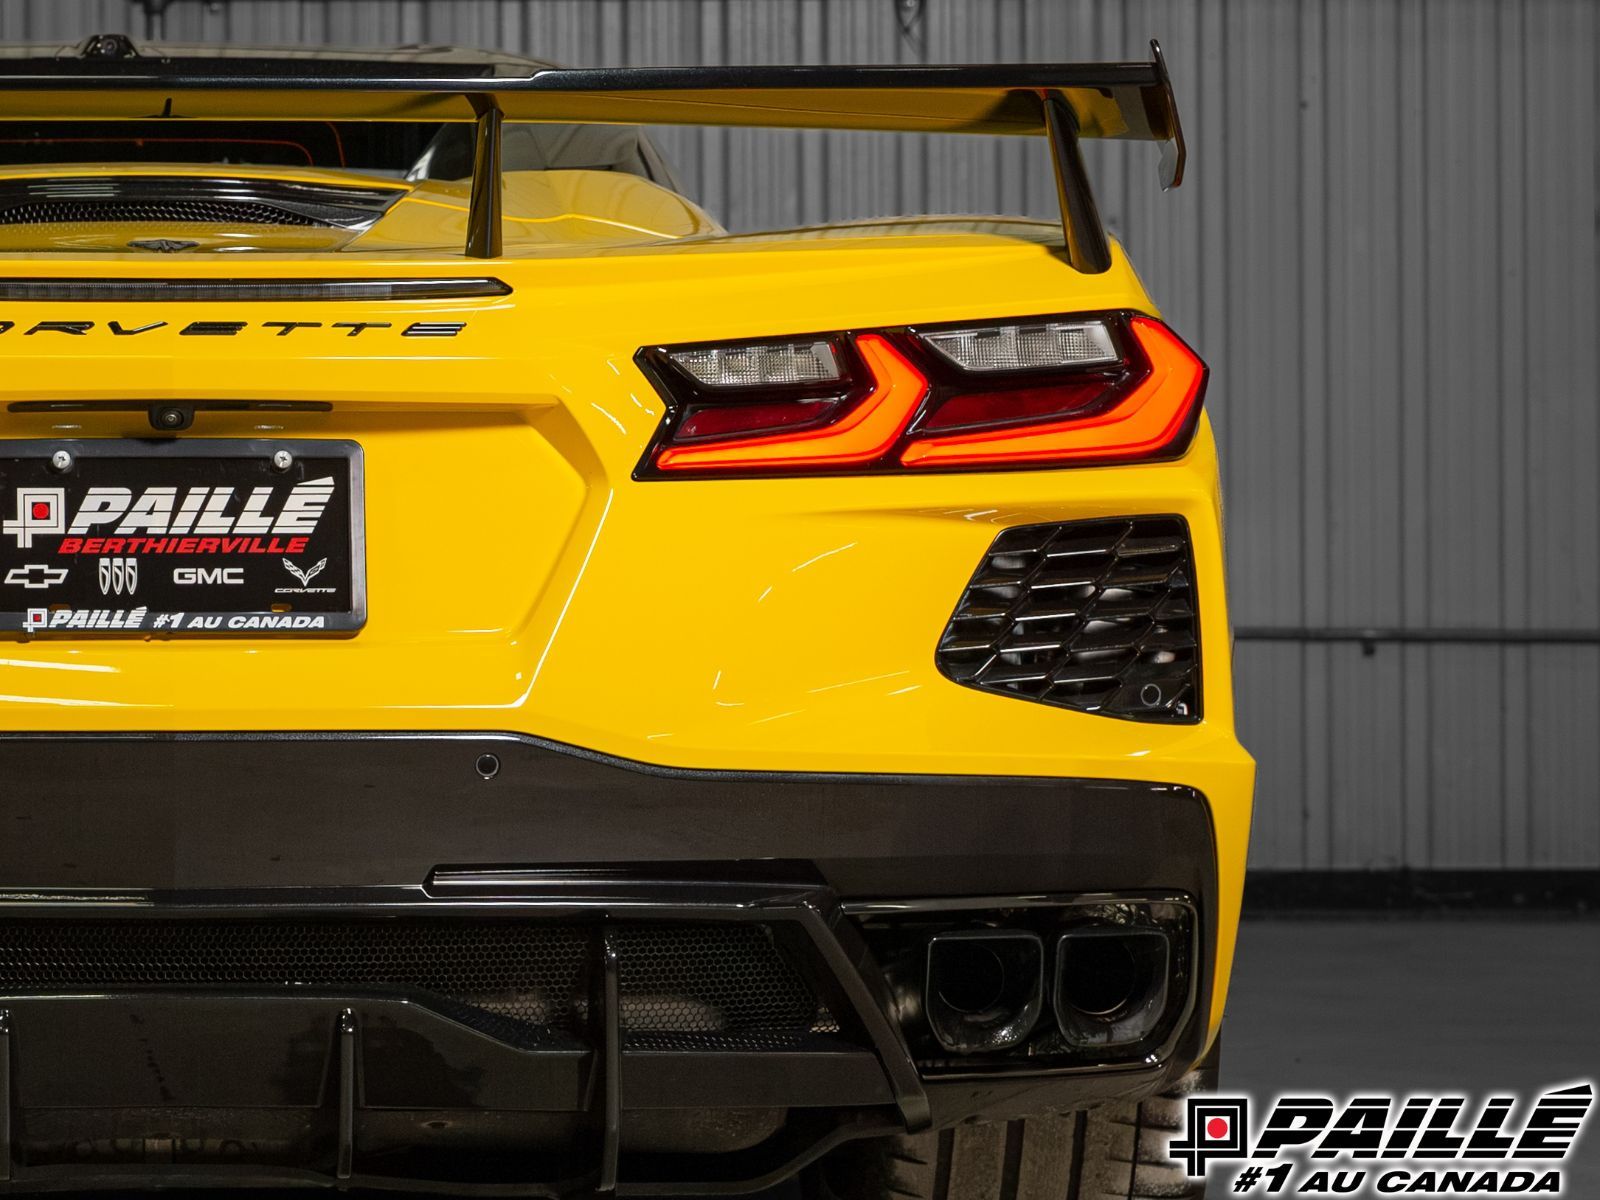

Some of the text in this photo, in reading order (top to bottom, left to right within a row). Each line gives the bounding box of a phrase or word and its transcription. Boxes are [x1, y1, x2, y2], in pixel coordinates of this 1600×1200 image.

[0, 320, 468, 337] RVETTE
[67, 476, 335, 535] PAILLÉ
[58, 537, 309, 554] BERTHIERVILLE
[173, 567, 244, 585] GMC
[48, 606, 325, 629] PAILLÉ #1 AU CANADA
